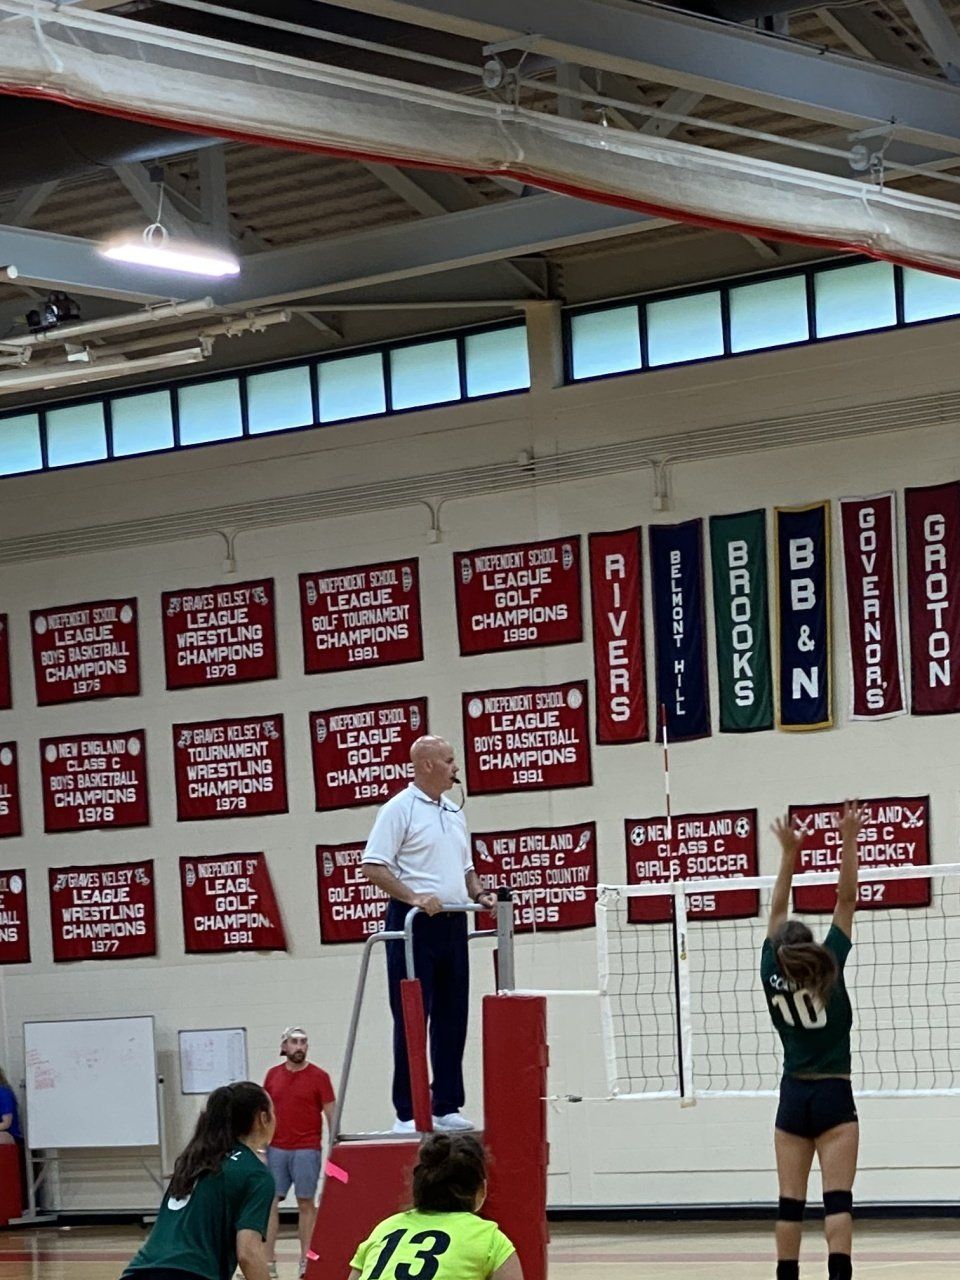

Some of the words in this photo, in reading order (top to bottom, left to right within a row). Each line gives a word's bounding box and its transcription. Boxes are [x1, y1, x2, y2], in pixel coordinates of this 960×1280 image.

[475, 552, 524, 573] INDEPENDENT
[528, 548, 558, 566] SCHOOL
[319, 573, 366, 594] INDEPENDENT
[370, 570, 398, 587] SCHOOL
[483, 568, 552, 591] LEAGUE
[789, 537, 816, 611] BB
[183, 594, 214, 611] GRAVES
[217, 589, 251, 608] KELSEY
[327, 588, 392, 612] LEAGUE
[496, 588, 542, 608] GOLF
[670, 550, 684, 648] BELMONT
[859, 507, 887, 709] GOVERNOR'S
[924, 514, 951, 688] GROTON
[93, 607, 118, 623] SCHOOL
[187, 608, 248, 629] LEAGUE
[312, 614, 339, 632] GOLF
[342, 605, 410, 628] TOURNAMENT
[472, 604, 568, 631] CHAMPIONS
[728, 540, 755, 707] BROOKS
[55, 625, 113, 646] LEAGUE
[177, 625, 263, 648] WRESTLING
[316, 624, 409, 650] CHAMPIONS
[504, 627, 537, 642] 1990
[605, 554, 630, 722] RIVERS
[797, 625, 815, 652] &
[41, 649, 65, 666] BOYS
[68, 641, 130, 662] BASKETBALL
[178, 643, 264, 666] CHAMPIONS
[348, 646, 379, 661] 1981
[46, 660, 127, 682] CHAMPIONS
[206, 664, 237, 678] 1978
[674, 660, 686, 715] HILL
[792, 667, 819, 699] N
[484, 694, 533, 714] INDEPENDENT
[536, 692, 566, 709] SCHOOL
[330, 711, 375, 732] INDEPENDENT
[379, 708, 407, 725] SCHOOL
[491, 711, 560, 732] LEAGUE
[194, 727, 224, 744] GRAVES
[228, 724, 261, 741] KELSEY
[337, 727, 402, 749] LEAGUE
[474, 736, 502, 753] BOYS
[506, 728, 580, 750] BASKETBALL
[59, 743, 78, 758] NEW
[81, 740, 126, 756] ENGLAND
[188, 741, 269, 763] TOURNAMENT
[348, 746, 392, 766] GOLF
[480, 748, 577, 771] CHAMPIONS
[67, 758, 107, 772] CLASS
[112, 758, 121, 769] C
[187, 760, 272, 780] WRESTLING
[327, 763, 415, 787] CHAMPIONS
[50, 775, 74, 790] BOYS
[77, 770, 138, 788] BASKETBALL
[188, 778, 273, 798] CHAMPIONS
[512, 770, 544, 784] 1991
[54, 788, 137, 807] CHAMPIONS
[216, 797, 247, 811] 1978
[648, 824, 672, 842] NEW
[678, 819, 732, 839] ENGLAND
[824, 828, 878, 846] CLSS
[883, 827, 894, 840] C
[494, 839, 516, 855] NEW
[520, 834, 573, 852] ENGLAND
[658, 841, 708, 857] CLASS
[714, 840, 725, 852] C
[502, 854, 550, 870] CLASS
[555, 853, 565, 866] C
[636, 860, 680, 877] GIRLS
[687, 854, 748, 874] SOCCER
[68, 873, 100, 888] GRAVES
[102, 870, 133, 886] KELSEY
[510, 871, 542, 888] CROSS
[546, 866, 590, 885] COUNTRY
[73, 888, 130, 905] LEAGUE
[216, 895, 258, 912] GOLF
[328, 887, 356, 903] GOLF
[62, 904, 145, 922] WRESTLING
[194, 914, 274, 931] CHAMPION
[62, 921, 146, 940] CHAMPIONS
[92, 940, 119, 952] 1977
[772, 988, 827, 1029] 10
